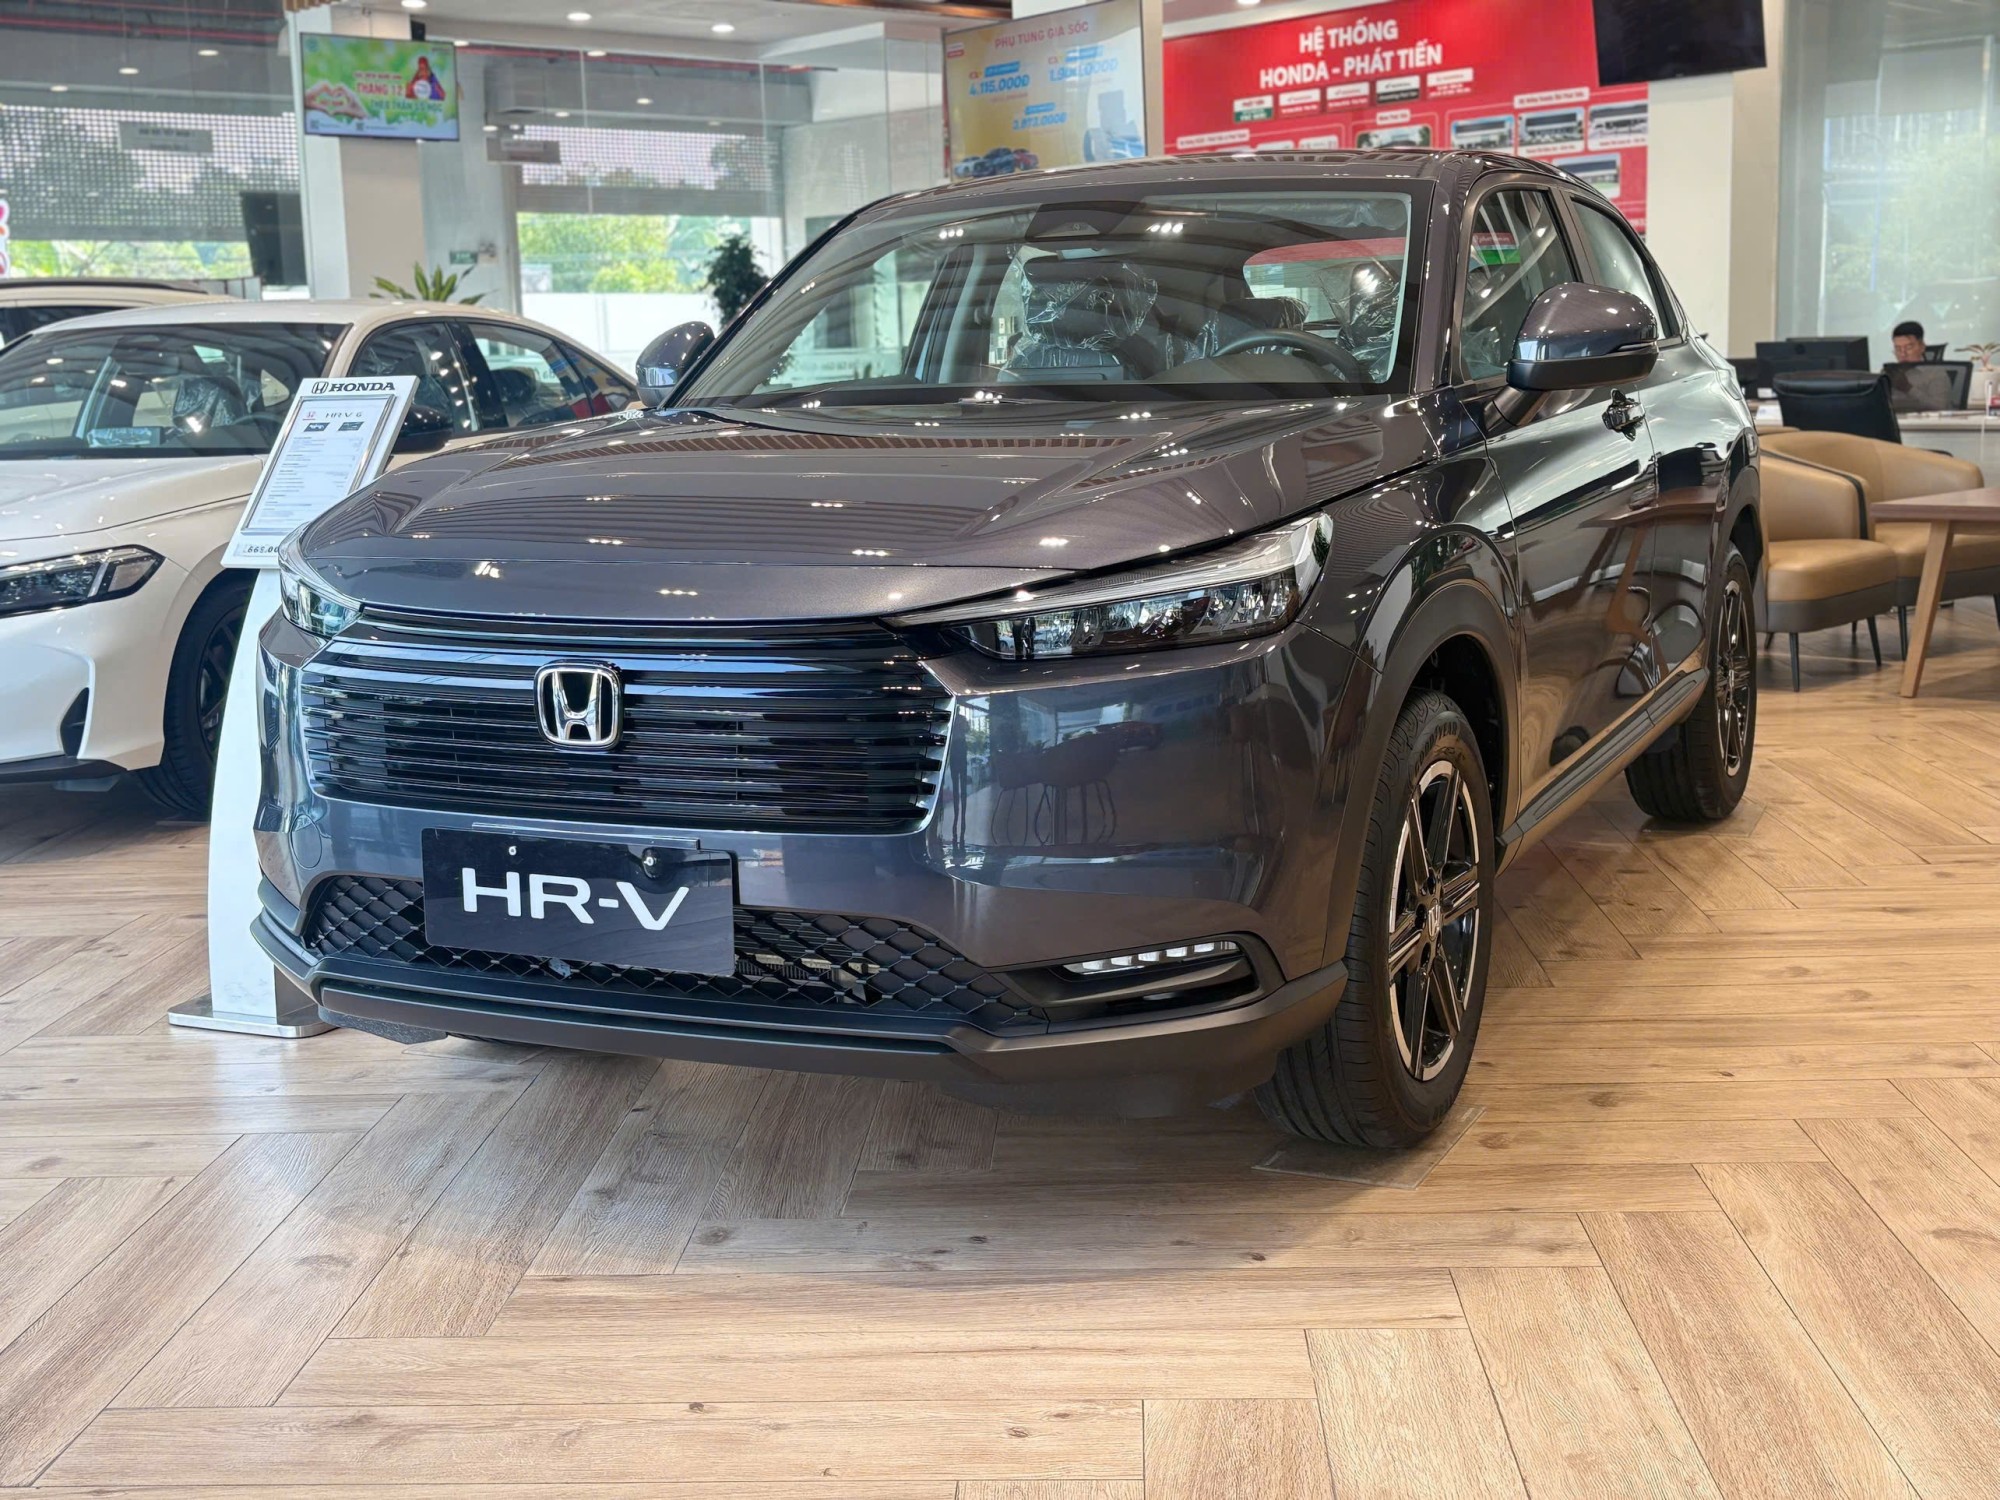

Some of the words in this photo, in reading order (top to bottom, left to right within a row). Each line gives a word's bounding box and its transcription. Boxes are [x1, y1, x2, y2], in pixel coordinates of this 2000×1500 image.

[1300, 26, 1324, 57] HỆ
[1327, 17, 1398, 49] THỐNG
[1260, 61, 1329, 89] HONDA
[1344, 47, 1395, 77] PHÁT
[1398, 39, 1442, 69] TIẾN
[329, 382, 395, 392] HONDA
[462, 867, 689, 931] HR-V
